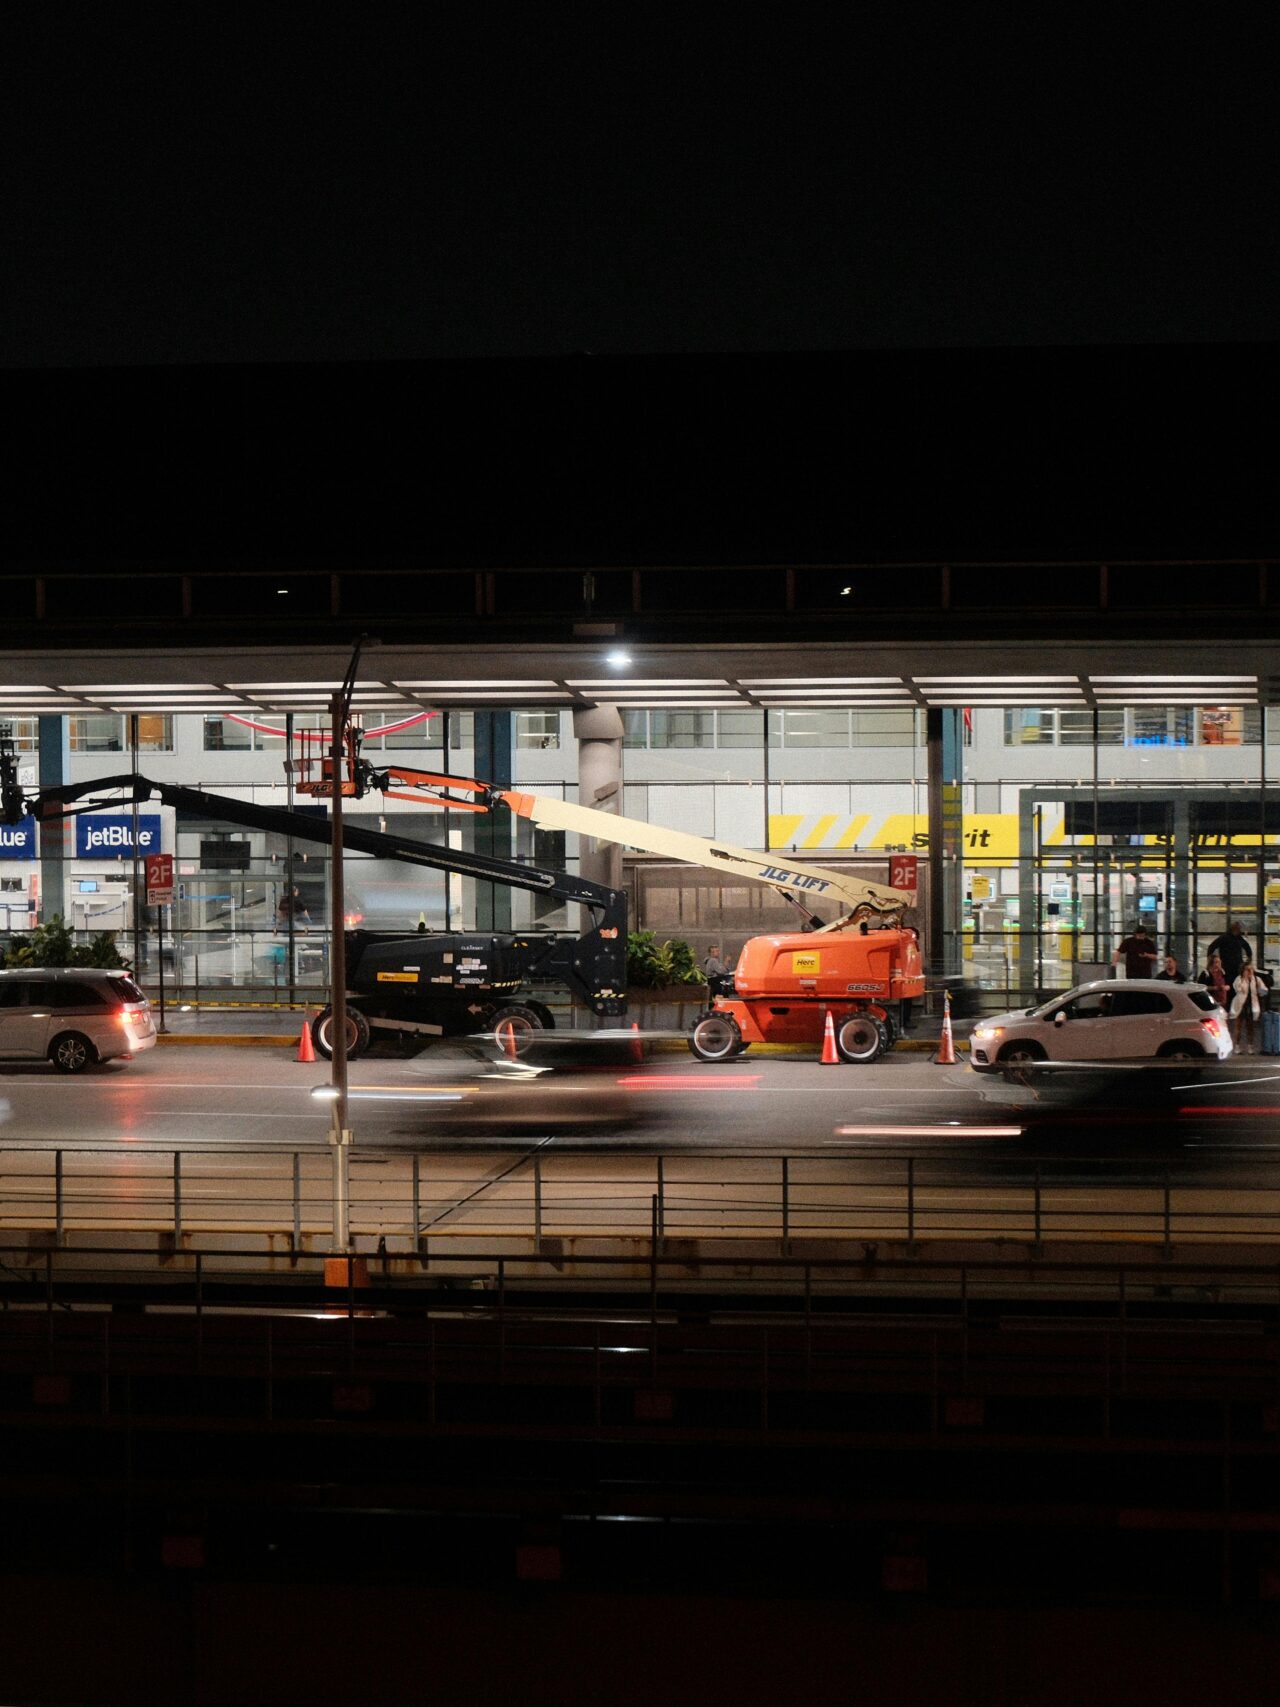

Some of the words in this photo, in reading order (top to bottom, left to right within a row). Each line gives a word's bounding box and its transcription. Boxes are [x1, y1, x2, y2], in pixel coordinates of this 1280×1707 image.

[85, 826, 151, 850] jetBlue
[910, 829, 991, 848] sit
[150, 865, 171, 884] 2F
[758, 866, 792, 882] JLG
[791, 873, 831, 893] LIFT
[894, 866, 916, 886] 2F
